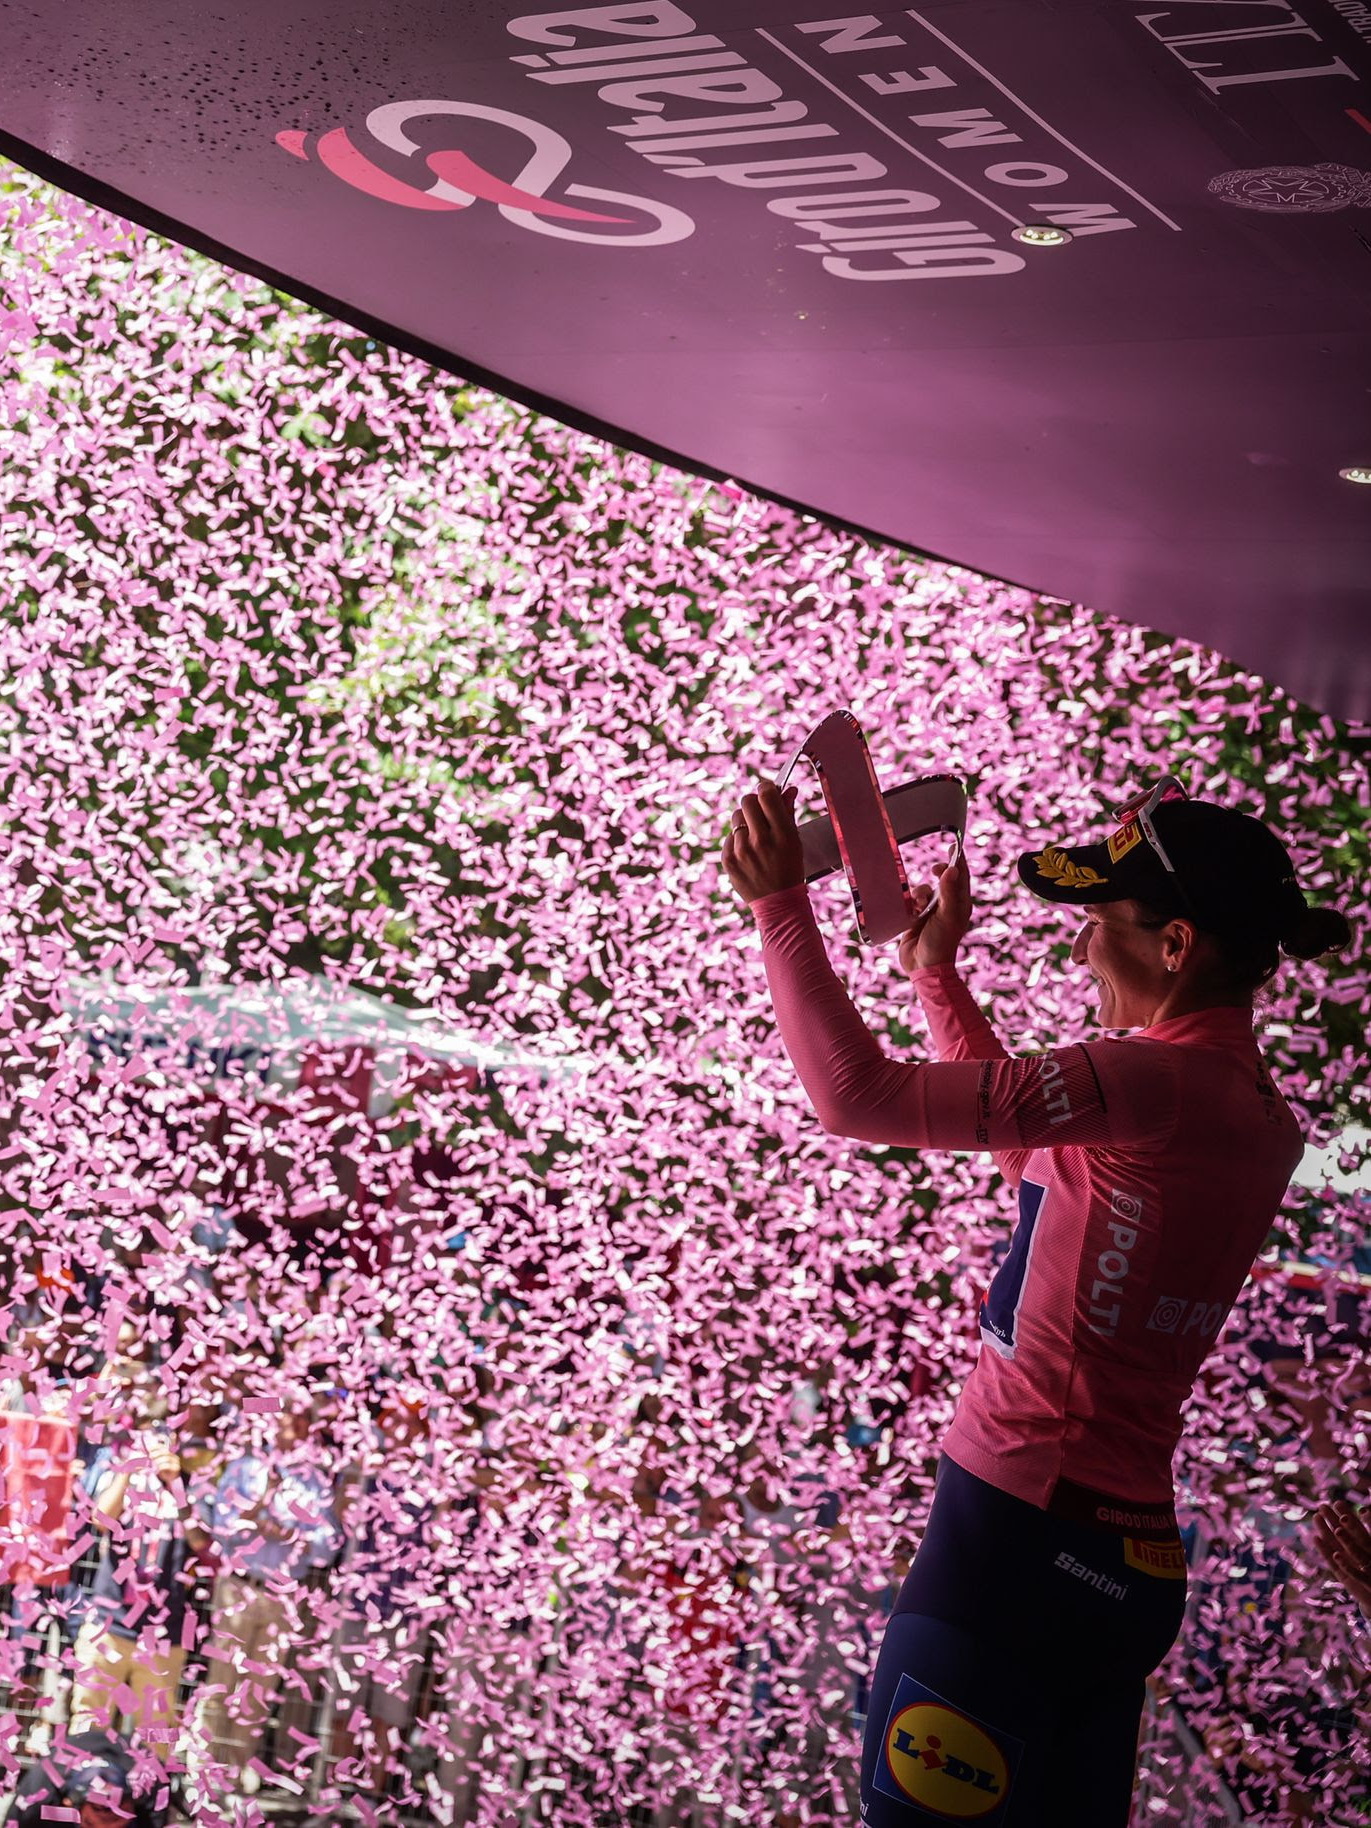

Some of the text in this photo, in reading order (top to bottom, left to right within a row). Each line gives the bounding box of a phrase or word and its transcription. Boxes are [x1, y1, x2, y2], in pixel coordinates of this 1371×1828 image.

[1135, 0, 1359, 94] IT
[794, 15, 1137, 236] WOMEN
[1089, 1221, 1137, 1336] POLTI
[1054, 1552, 1128, 1600] Santini
